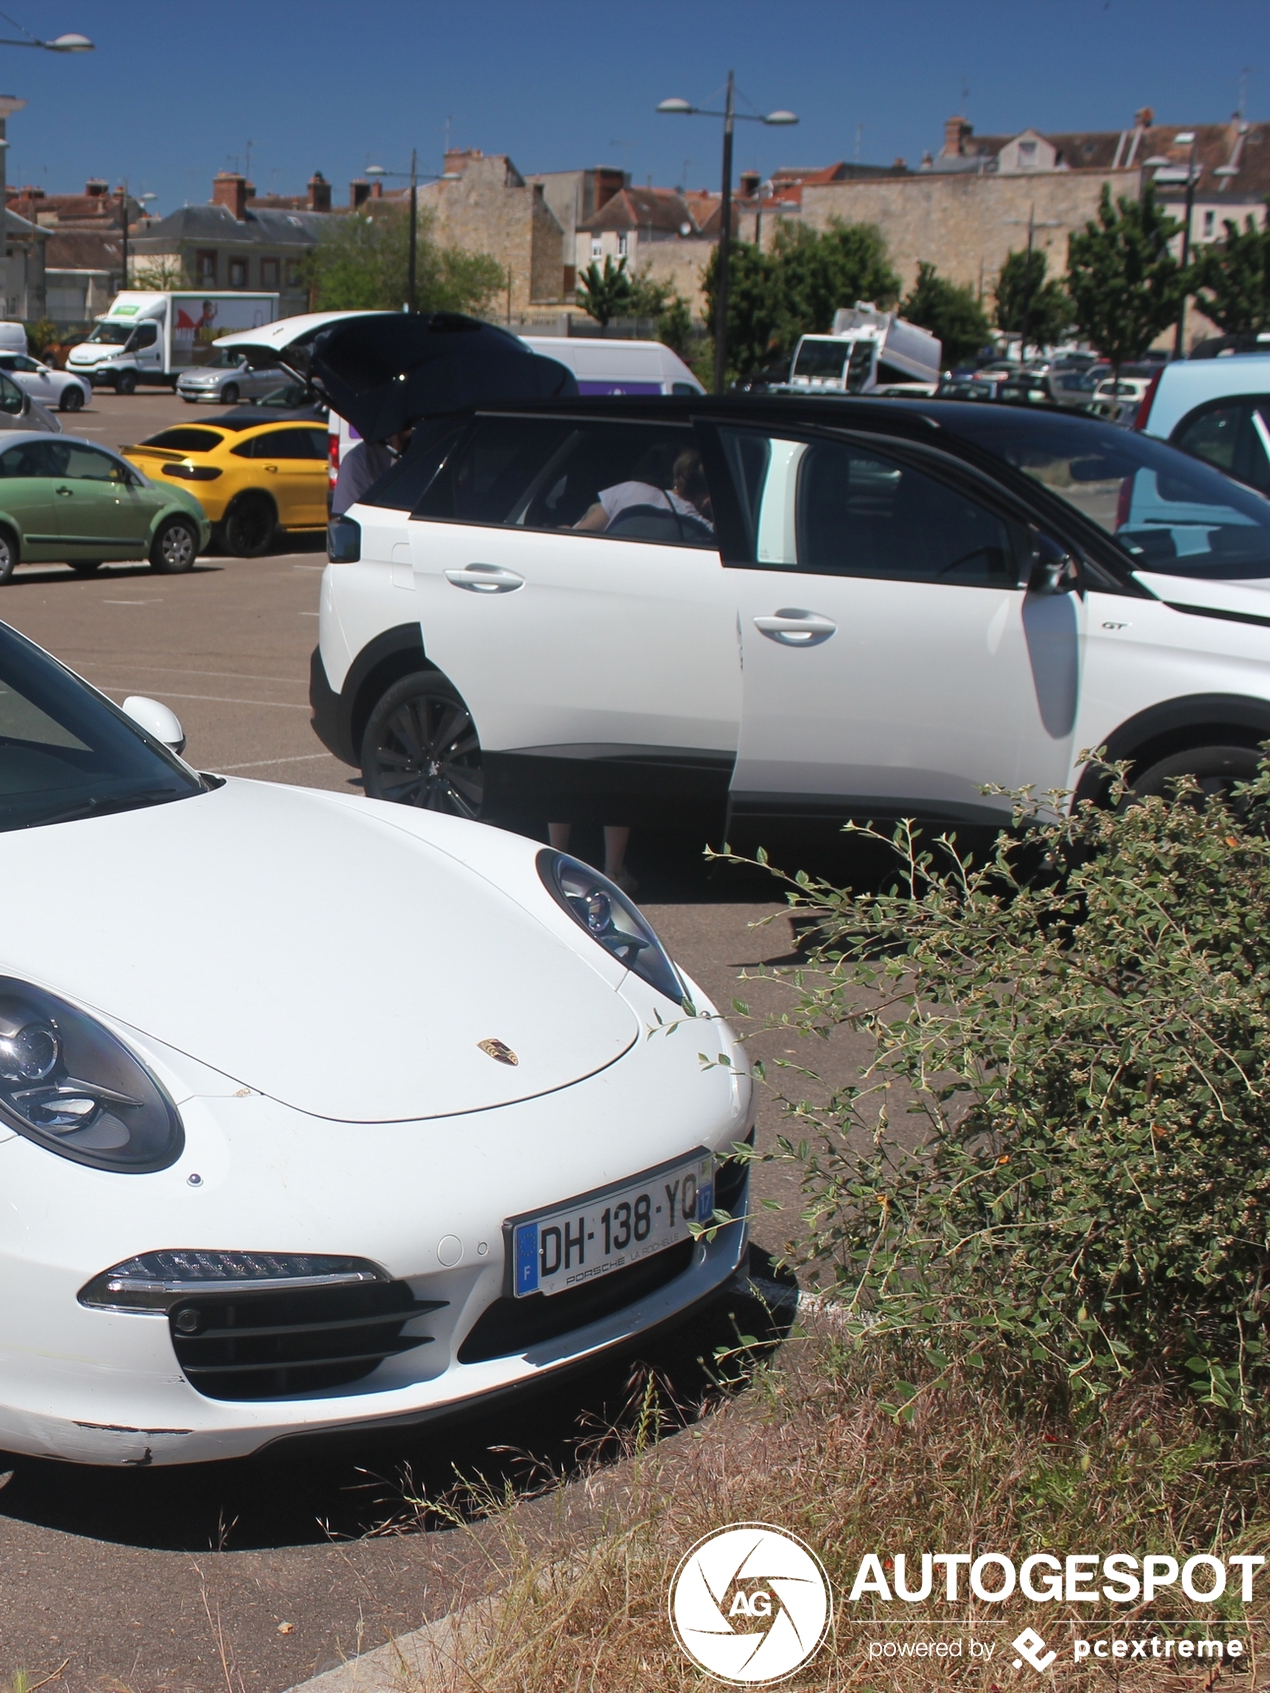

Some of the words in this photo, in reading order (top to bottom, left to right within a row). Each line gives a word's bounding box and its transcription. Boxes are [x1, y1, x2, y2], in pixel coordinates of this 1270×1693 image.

[1102, 621, 1130, 630] GT
[566, 1256, 626, 1286] PORSCHE
[630, 1252, 641, 1262] LA
[642, 1233, 680, 1256] ROCHELLE
[523, 1264, 531, 1281] F
